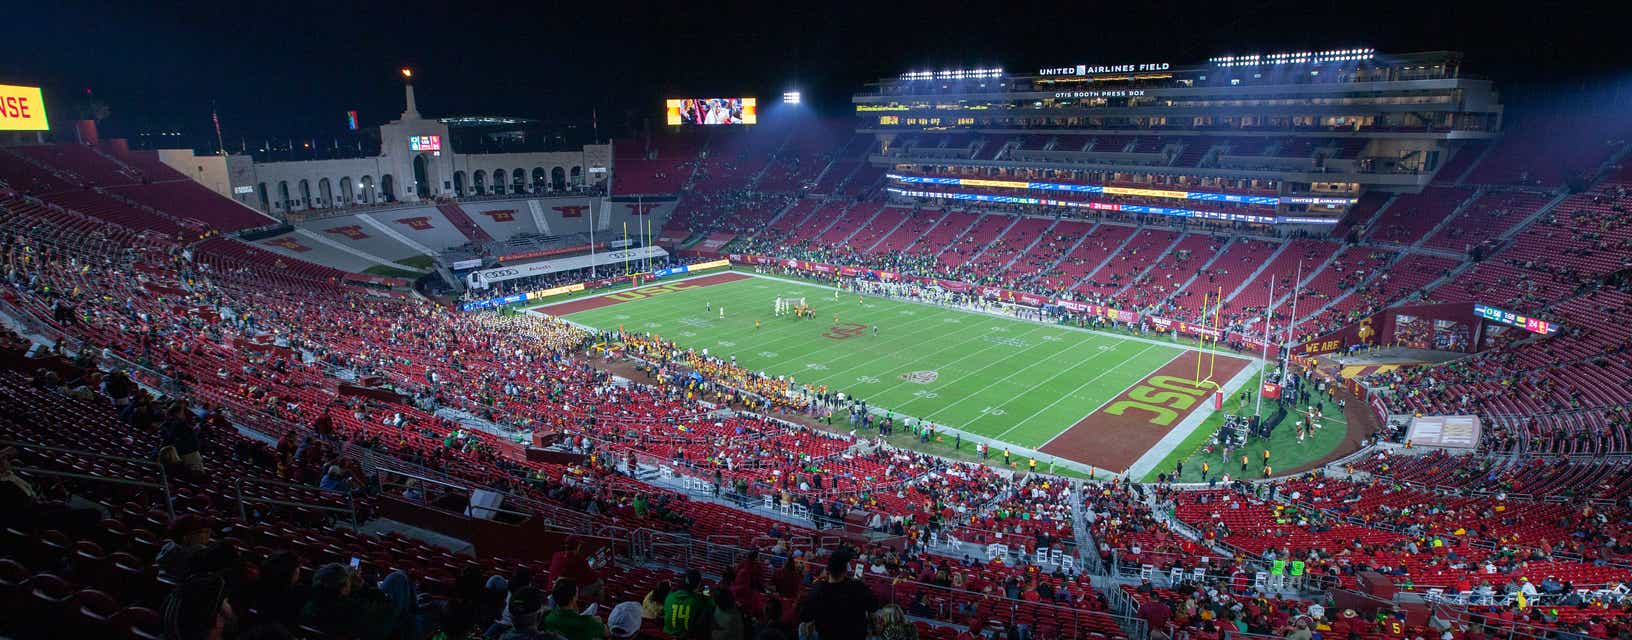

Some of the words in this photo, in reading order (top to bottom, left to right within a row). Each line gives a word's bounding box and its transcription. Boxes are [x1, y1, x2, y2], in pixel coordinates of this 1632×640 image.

[1039, 67, 1075, 76] UNITED
[1087, 64, 1135, 74] AIRLINES
[1139, 62, 1170, 71] FIELD
[605, 282, 700, 301] USC
[1305, 343, 1320, 353] WE
[1321, 340, 1341, 352] ARE
[1103, 375, 1217, 426] USC
[671, 604, 690, 630] 14
[1392, 622, 1400, 634] 5
